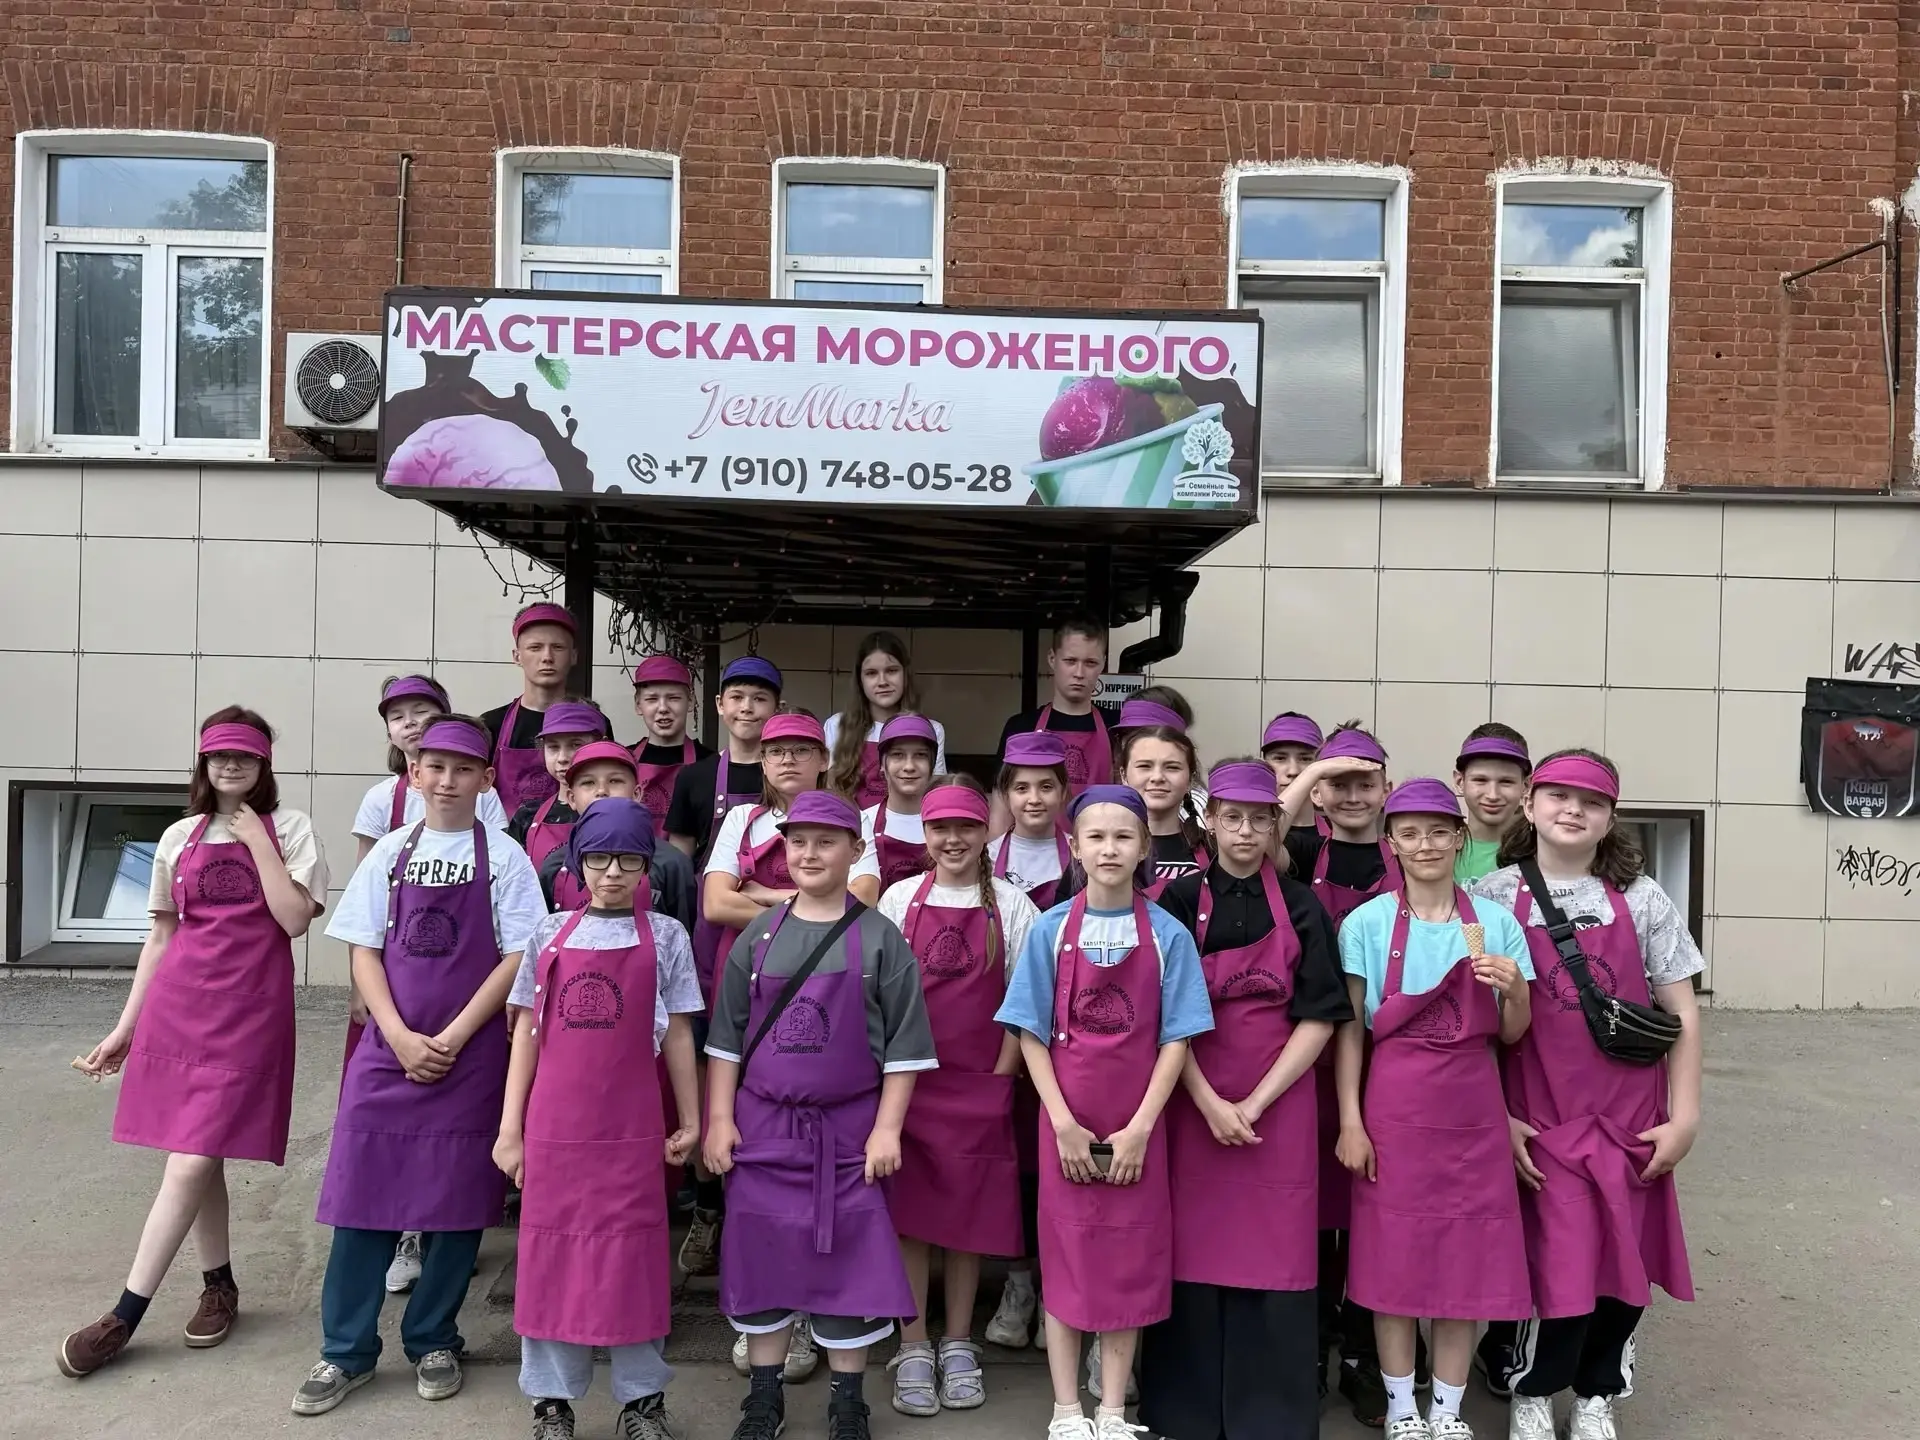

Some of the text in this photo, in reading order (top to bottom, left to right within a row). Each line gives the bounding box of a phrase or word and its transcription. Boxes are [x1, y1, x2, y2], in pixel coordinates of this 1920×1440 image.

[406, 310, 1230, 375] МАСТЕРСКАЯ МОРОЖЕНОГО
[687, 379, 955, 440] JemMarka
[664, 455, 1012, 493] +7 (910) 748-05-28
[1211, 490, 1236, 498] России
[1846, 796, 1885, 808] ВАРВАР
